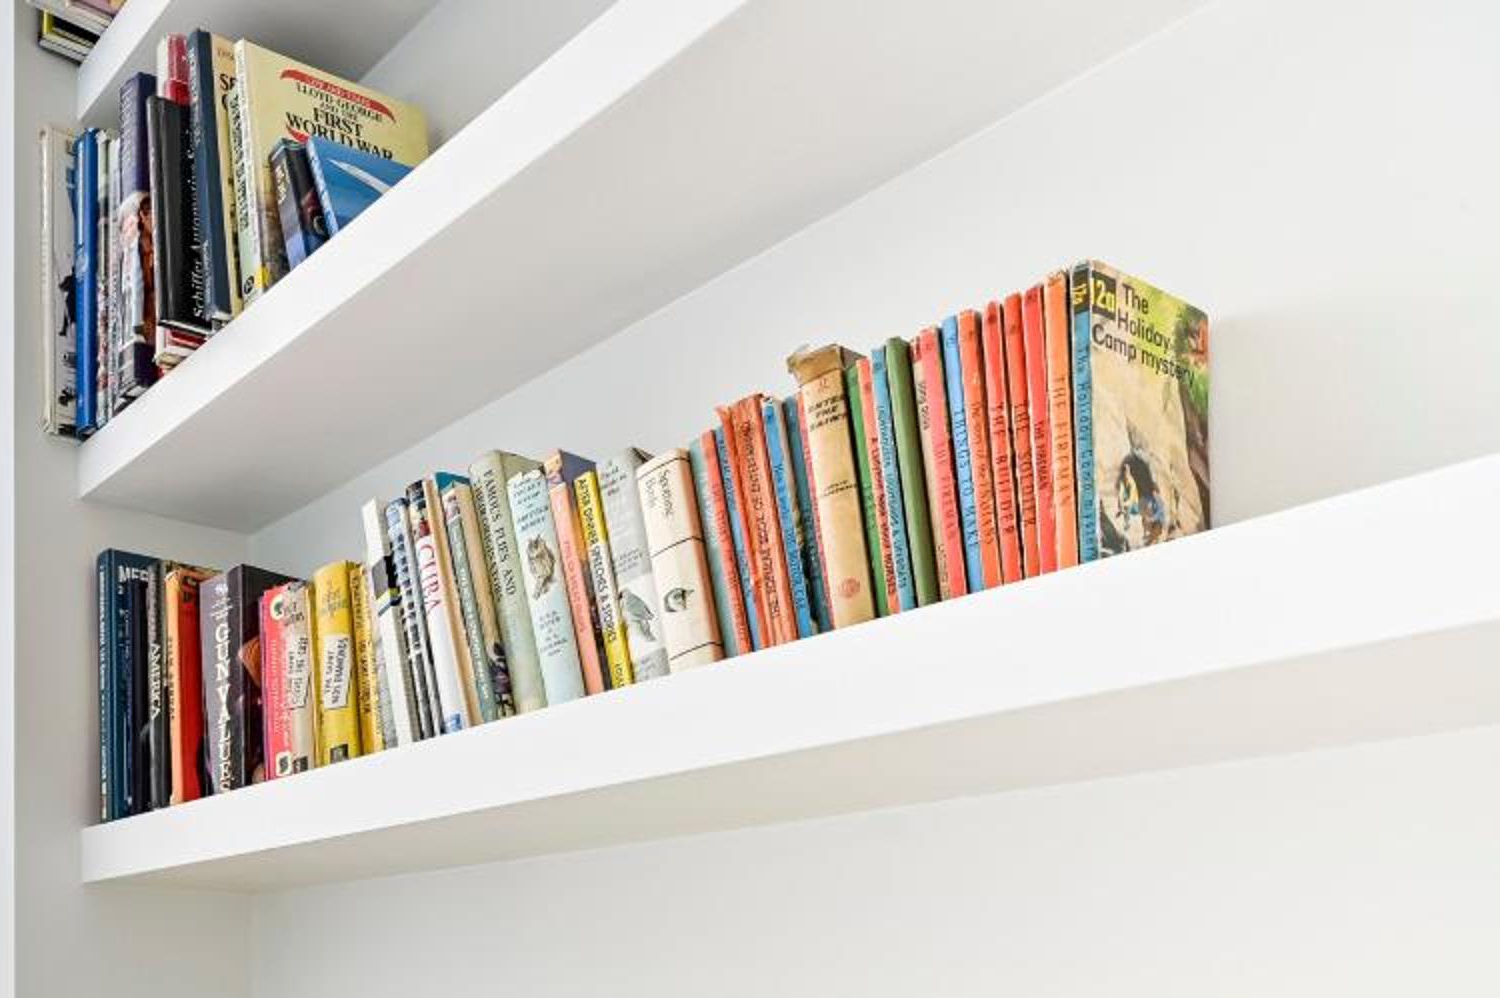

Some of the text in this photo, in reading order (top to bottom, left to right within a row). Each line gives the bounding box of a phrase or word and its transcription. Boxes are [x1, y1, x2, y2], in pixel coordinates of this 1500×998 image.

[295, 82, 333, 103] LLOYD
[336, 98, 382, 122] GEORGE
[313, 107, 364, 137] FIRST
[286, 111, 353, 147] WORLD
[192, 259, 203, 317] Schiffer
[1122, 283, 1149, 315] The
[1092, 323, 1195, 386] Camp mystery
[1117, 308, 1170, 354] Holiday
[1052, 373, 1066, 409] THE
[1077, 383, 1091, 440] Holiday
[952, 408, 980, 551] THINGS TO MAKE
[990, 401, 1015, 535] THE BUILDER
[1013, 400, 1037, 527] THE SOLDIER
[1080, 449, 1093, 491] Camp
[577, 477, 592, 507] AFTER
[484, 469, 517, 596] FAMOUS FLIES AND
[582, 507, 599, 545] DINNER
[420, 543, 442, 616] CUBA
[589, 544, 608, 592] SPEECHES
[883, 553, 896, 594] HORSES
[214, 623, 231, 682] GUN
[148, 642, 161, 720] AMERICA
